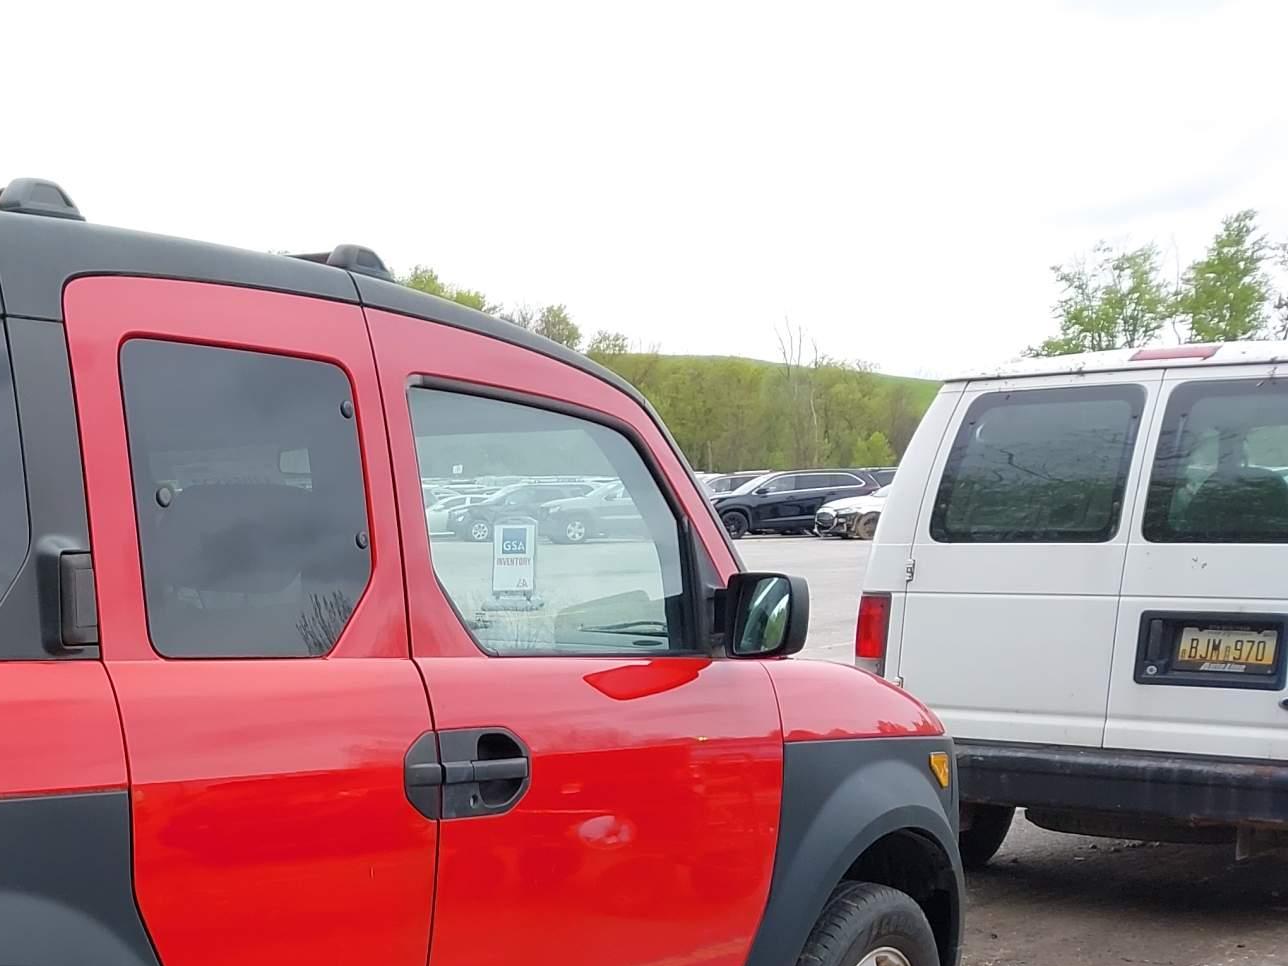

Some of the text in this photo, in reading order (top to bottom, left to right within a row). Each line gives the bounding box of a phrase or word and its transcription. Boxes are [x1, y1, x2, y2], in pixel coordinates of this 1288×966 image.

[503, 541, 525, 551] GSA
[1188, 638, 1267, 662] BJM 970
